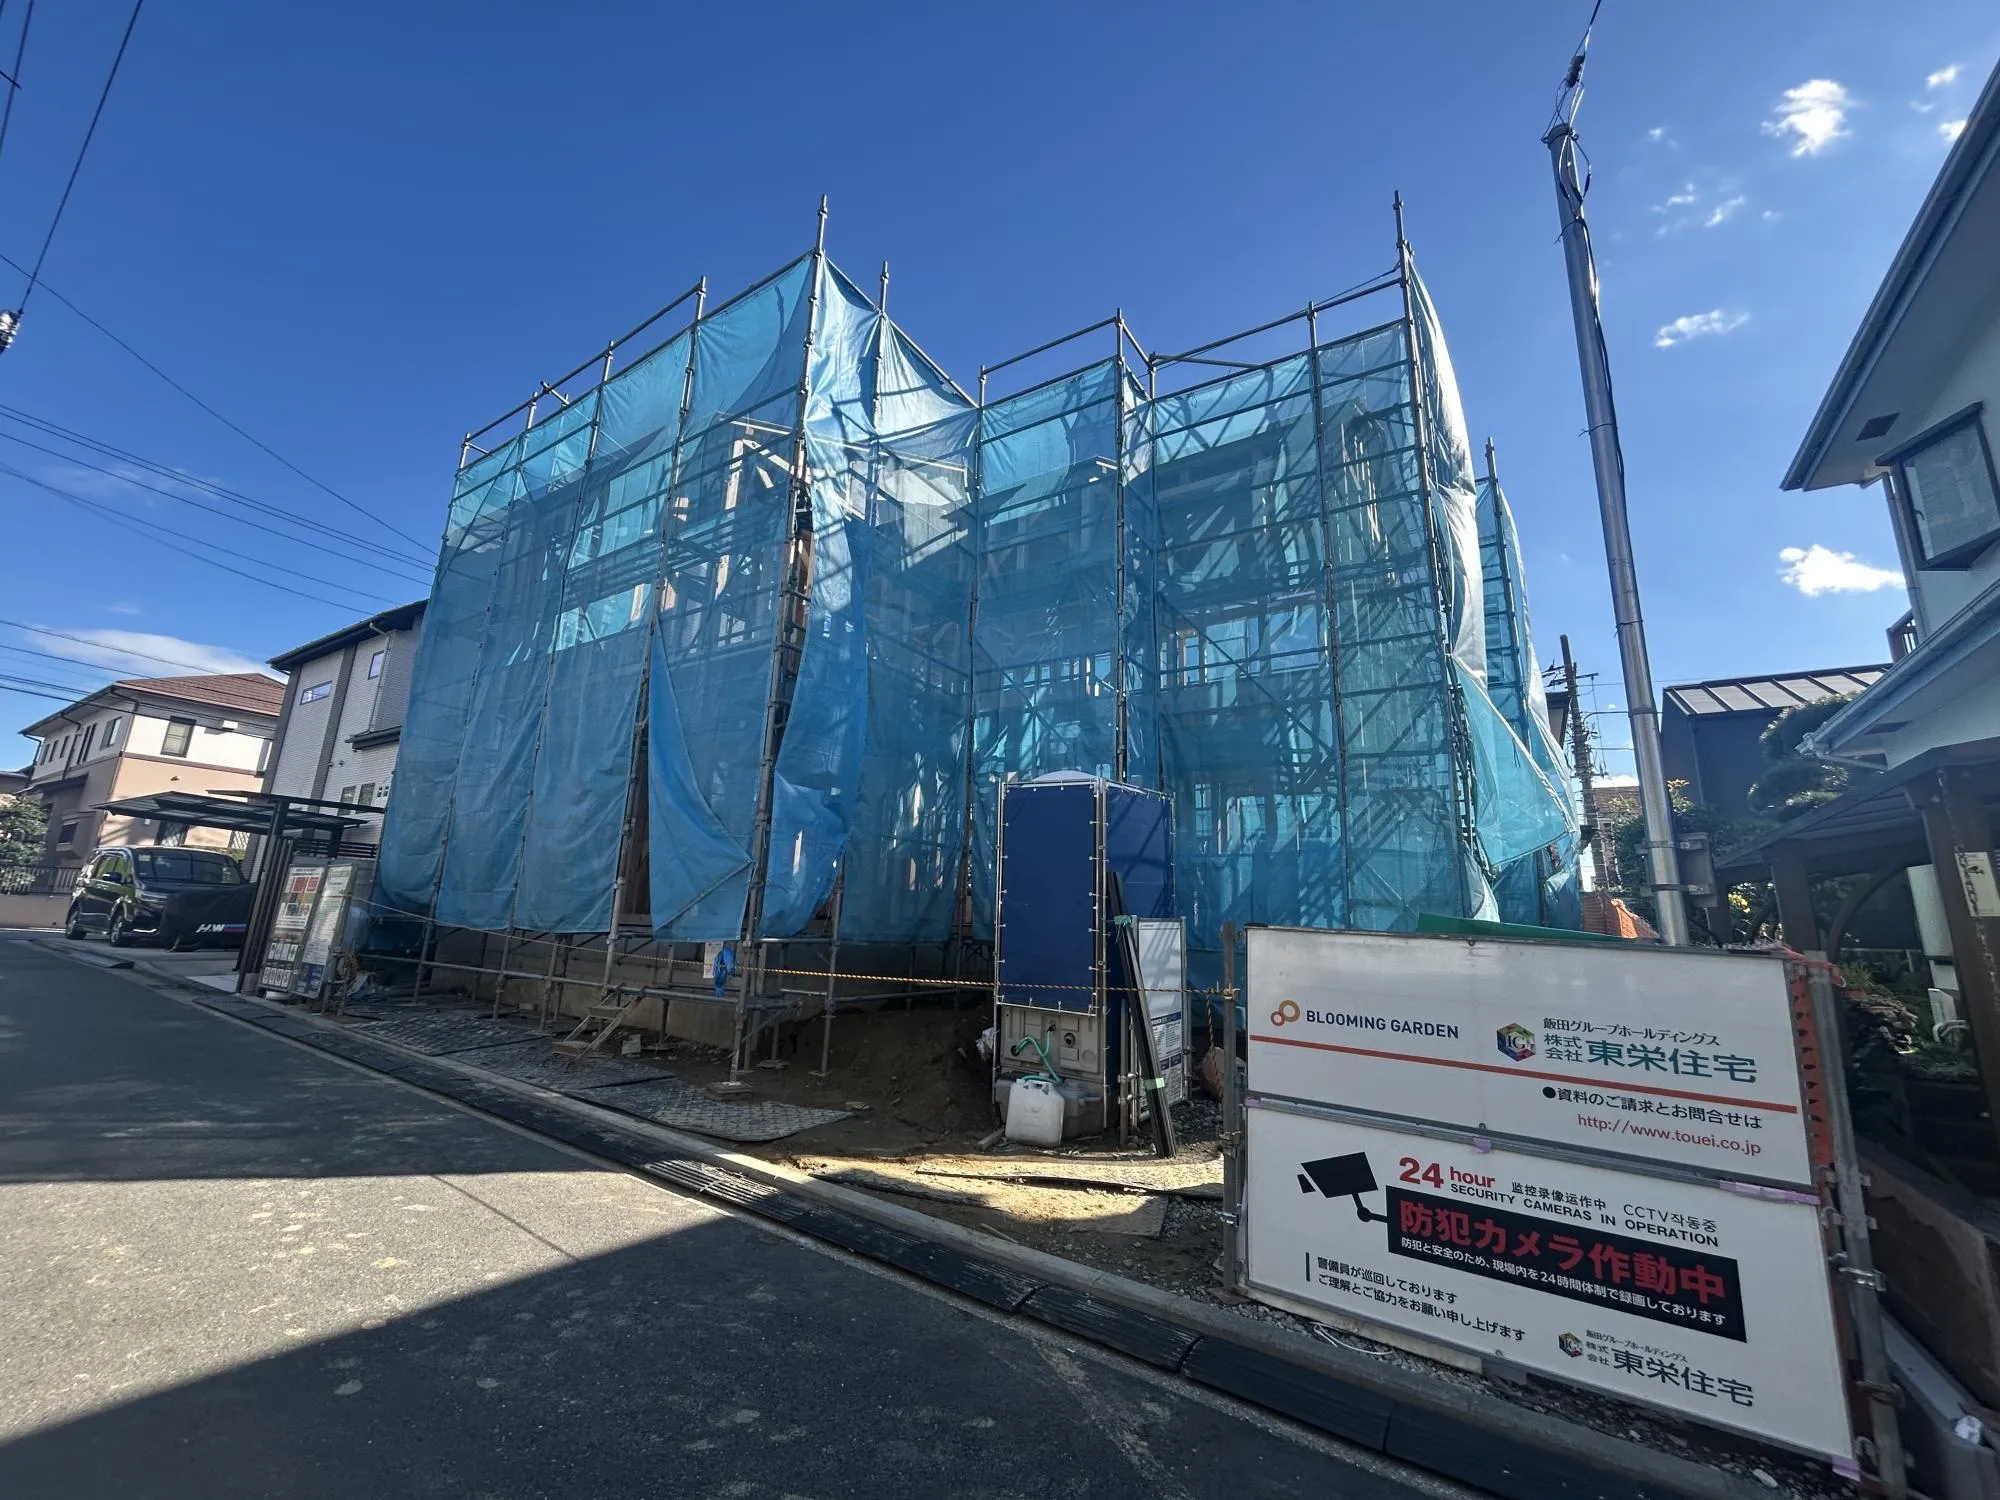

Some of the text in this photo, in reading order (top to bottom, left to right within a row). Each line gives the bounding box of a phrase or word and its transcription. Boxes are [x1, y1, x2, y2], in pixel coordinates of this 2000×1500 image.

[1306, 1010, 1459, 1039] BLOOMING GARDEN
[1543, 1018, 1720, 1047] 飯田グループホールディングス
[1543, 1033, 1582, 1050] 株式
[1545, 1047, 1583, 1064] 会社
[1585, 1039, 1758, 1084] 東栄住宅
[1577, 1113, 1761, 1156] http://www.touei.co.jp
[1399, 1157, 1496, 1188] 24 hour
[1511, 1181, 1606, 1211] 监控录像运作中
[1450, 1183, 1719, 1247] SECURITY CAMERAS IN OPERATION
[1623, 1204, 1717, 1233] CCTV작동중
[1400, 1200, 1726, 1305] 防犯カメラ作動中
[1317, 1256, 1458, 1304] 警備員が巡回しております
[1318, 1274, 1526, 1341] ご理解とご協力をお願い申し上げます
[1611, 1347, 1754, 1408] 東栄住宅
